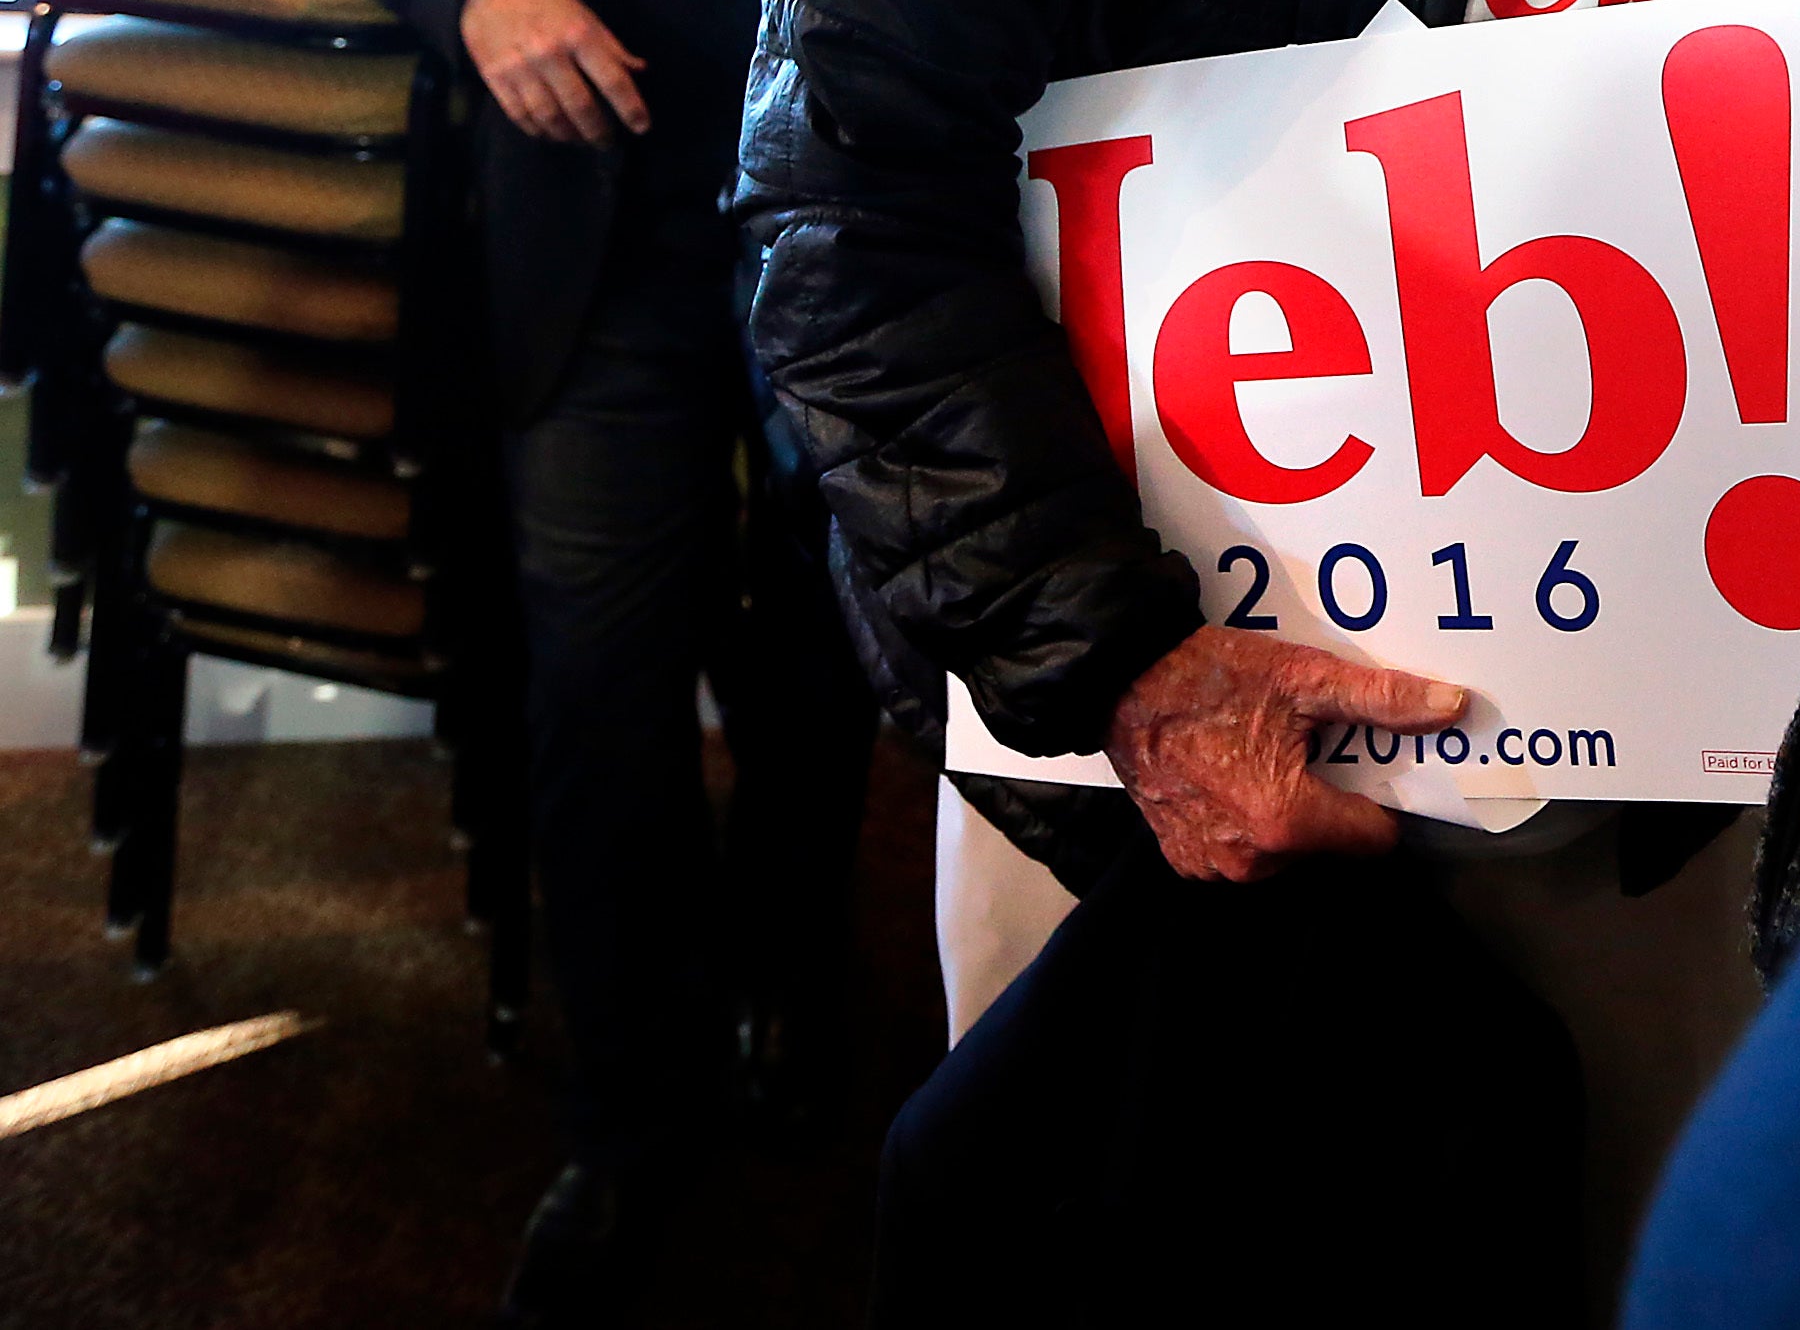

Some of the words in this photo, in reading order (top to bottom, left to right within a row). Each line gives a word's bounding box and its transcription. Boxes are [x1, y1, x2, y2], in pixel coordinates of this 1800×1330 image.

[1216, 540, 1600, 632] 2016
[1708, 756, 1739, 769] Paid
[1743, 757, 1763, 770] for
[1767, 758, 1776, 770] b
